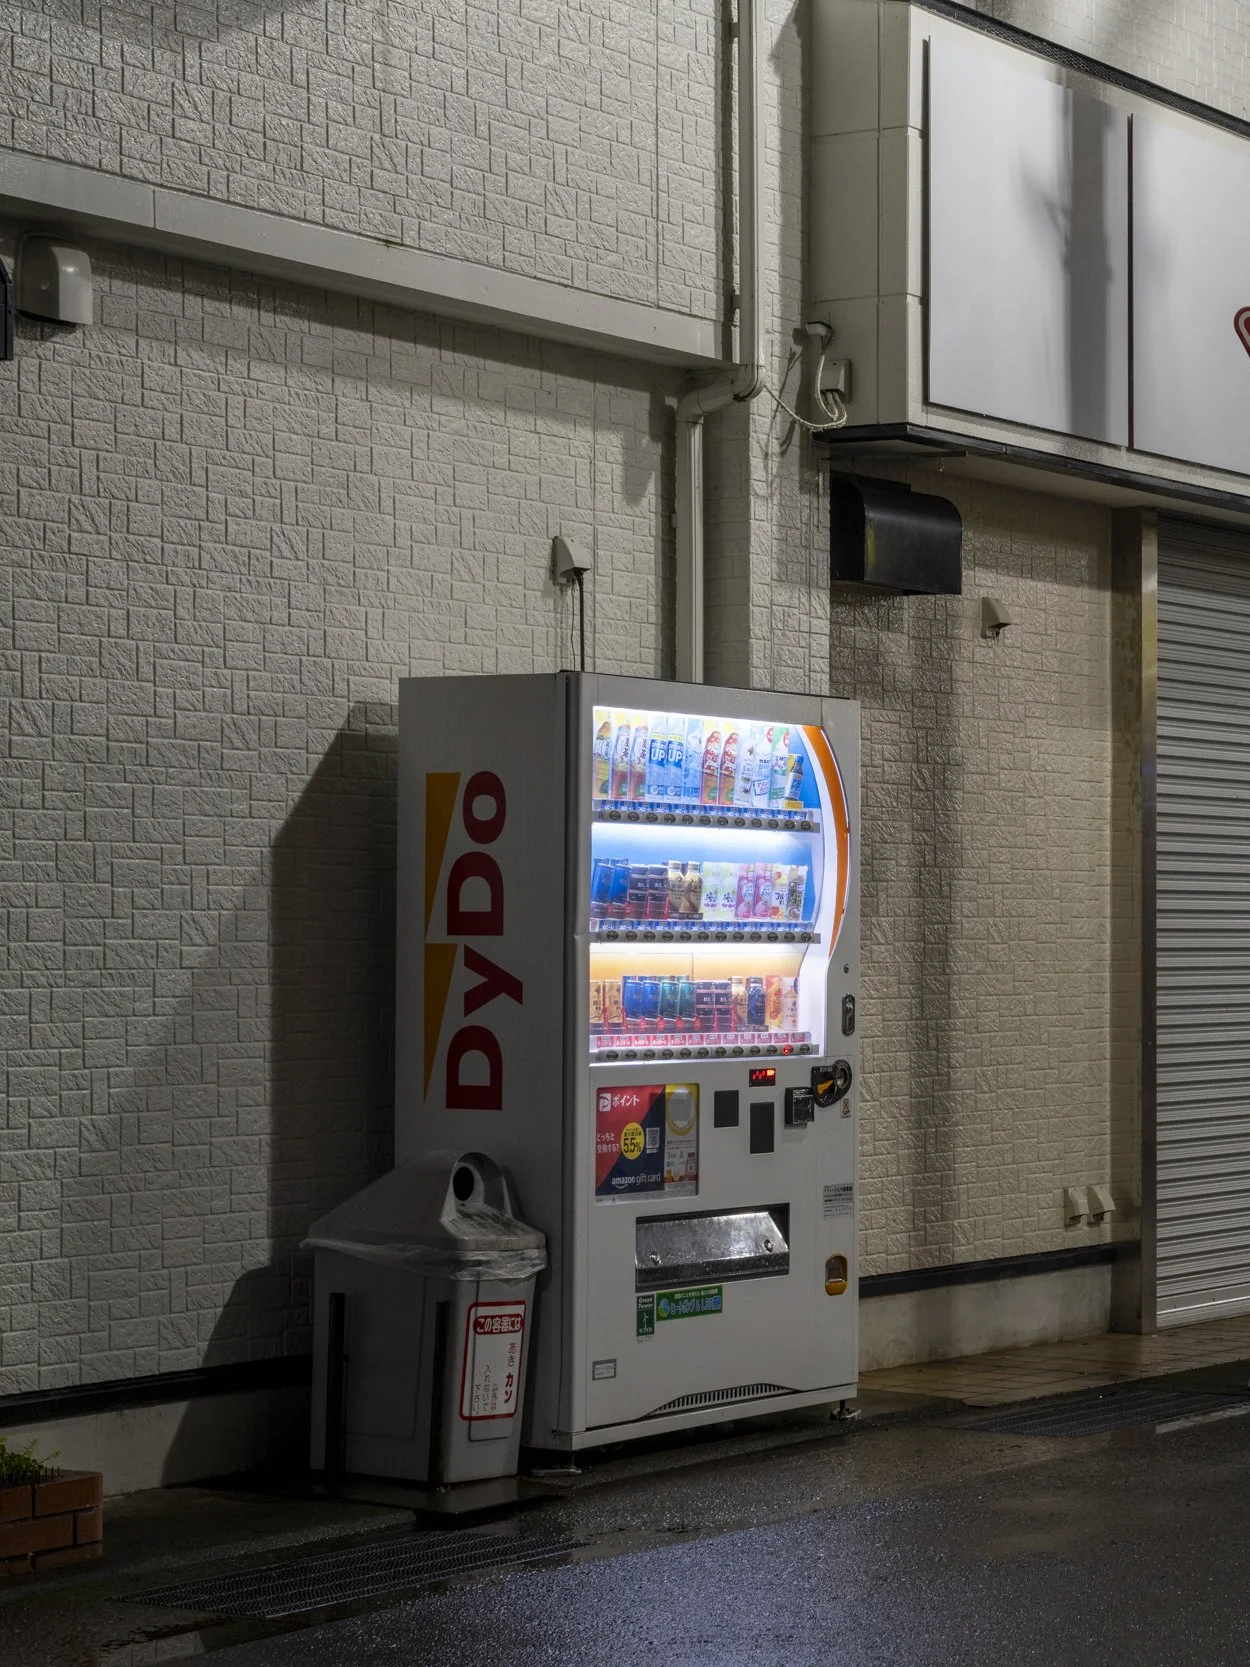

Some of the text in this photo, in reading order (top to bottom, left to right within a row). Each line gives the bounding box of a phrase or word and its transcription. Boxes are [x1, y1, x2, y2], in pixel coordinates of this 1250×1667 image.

[446, 770, 522, 1110] DyDo
[612, 1094, 640, 1108] ポイント
[611, 1172, 661, 1186] amazon gift card
[477, 1317, 522, 1332] この容器には
[483, 1366, 492, 1411] 入れないで
